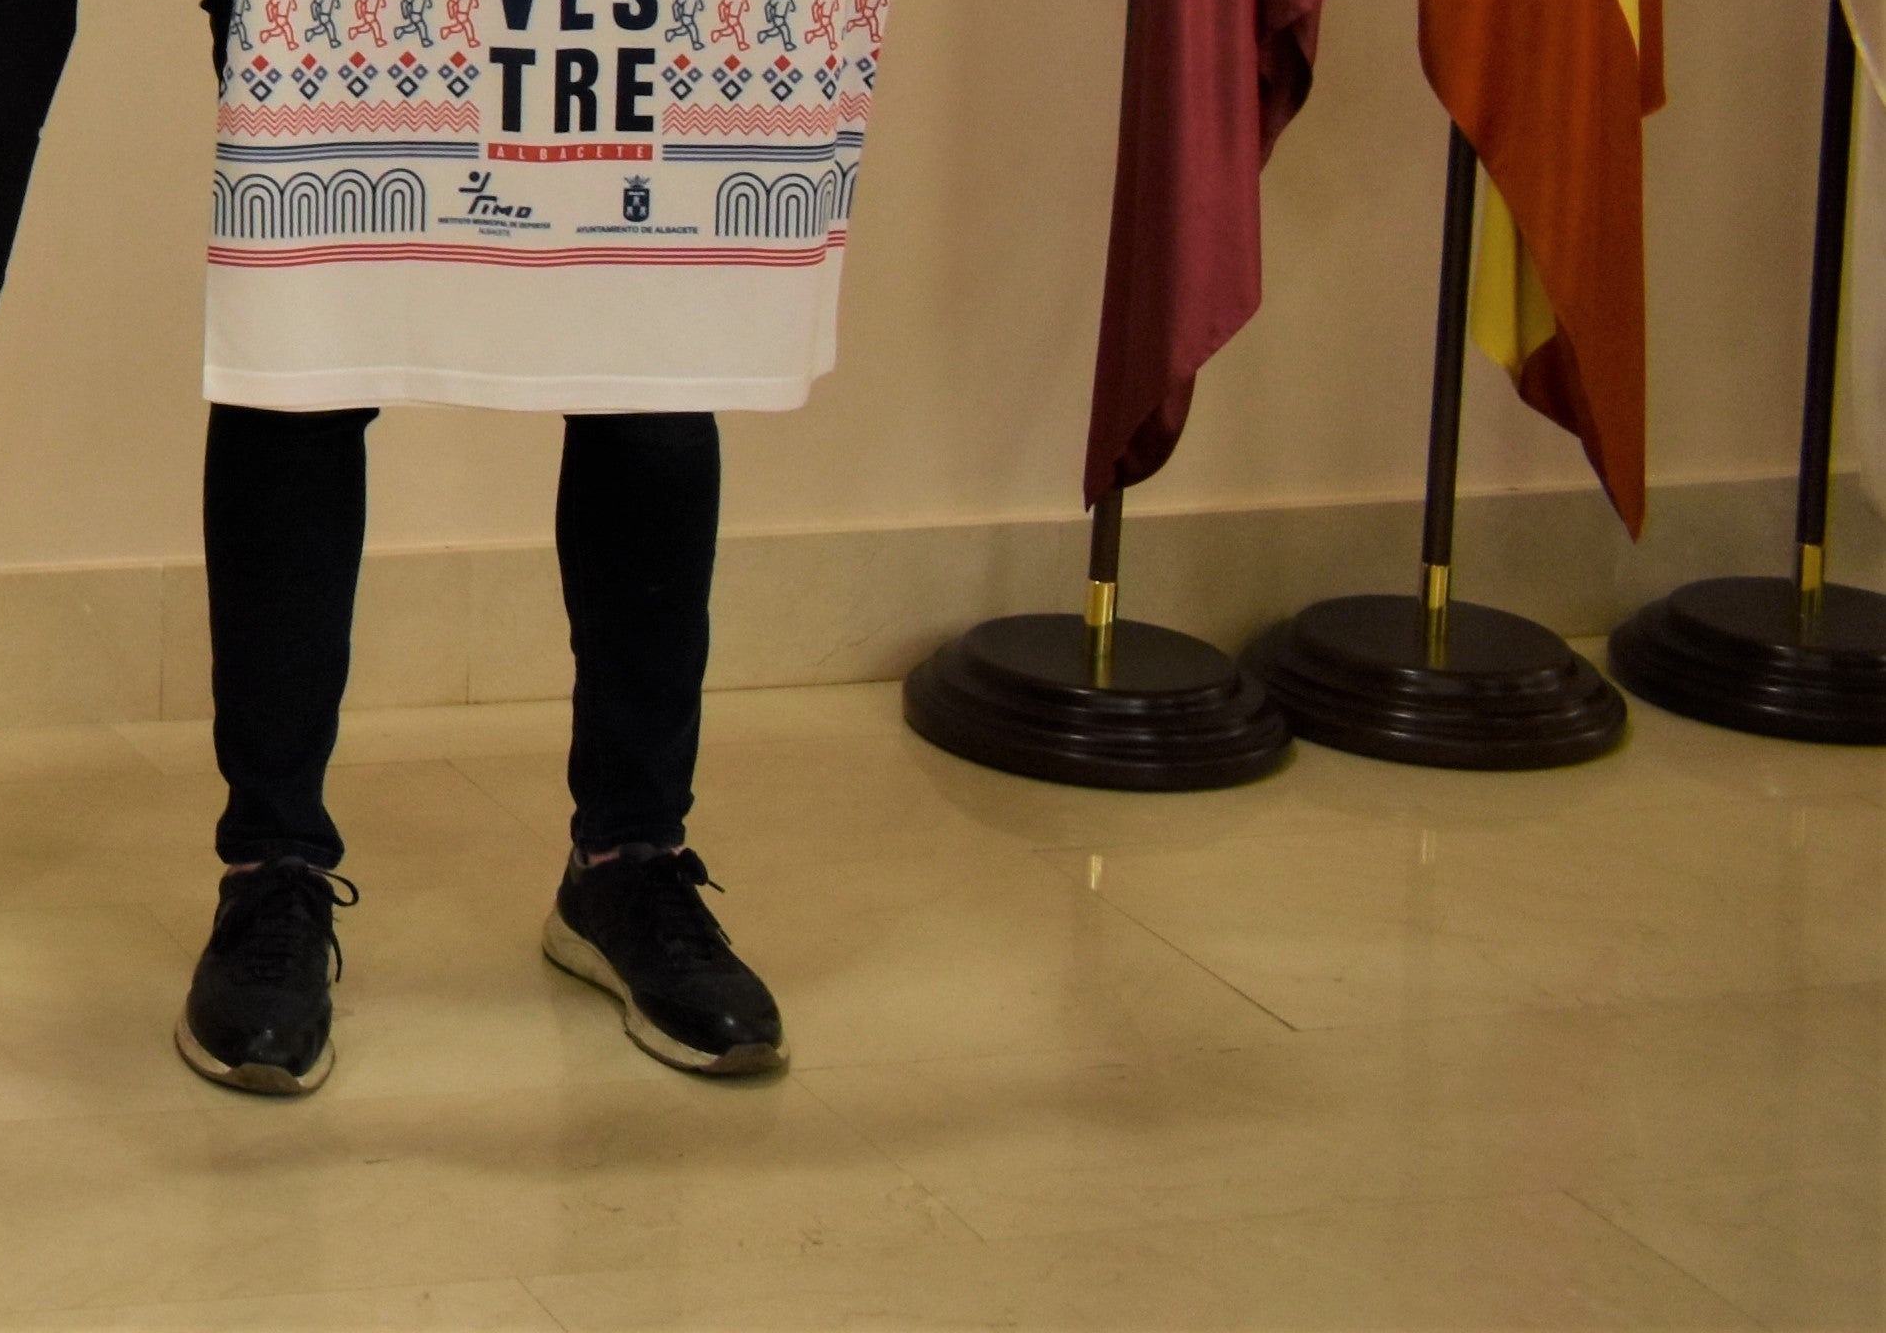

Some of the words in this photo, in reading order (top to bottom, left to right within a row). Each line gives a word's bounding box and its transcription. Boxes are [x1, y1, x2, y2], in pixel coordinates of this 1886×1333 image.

[490, 47, 655, 134] TRE
[496, 145, 645, 161] ALBACETE
[576, 226, 640, 234] AYUNTAMIENTO
[641, 226, 653, 234] DE
[655, 226, 698, 235] ALBACETE
